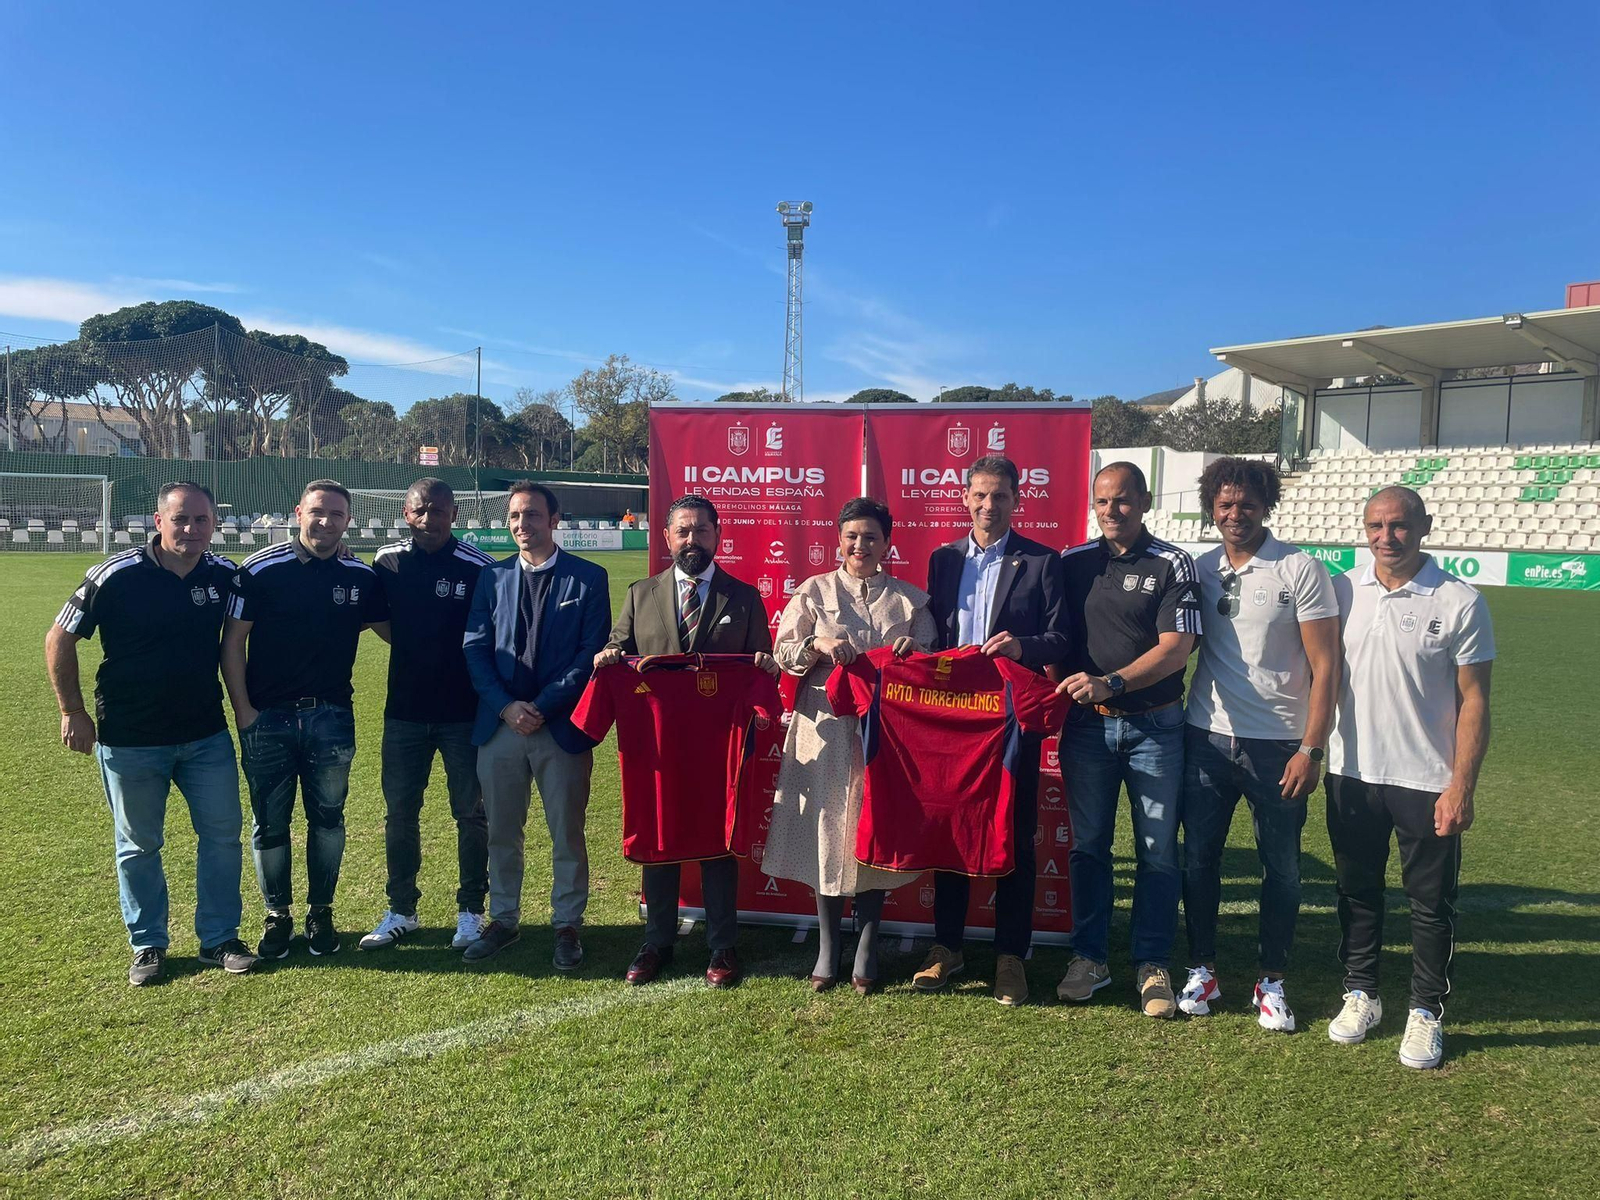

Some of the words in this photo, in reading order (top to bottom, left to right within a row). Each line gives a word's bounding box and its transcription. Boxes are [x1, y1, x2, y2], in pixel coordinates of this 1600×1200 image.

[684, 466, 697, 483] II
[702, 466, 826, 484] CAMPUS
[901, 468, 915, 485] II
[684, 486, 761, 497] LEYENDAS
[766, 485, 825, 498] ESPAÑA
[901, 489, 964, 498] LEYEND
[712, 503, 766, 511] ORREMOLINOS
[769, 503, 802, 511] MÁLAGA
[925, 505, 968, 513] TORREMOL
[763, 518, 776, 526] DEL
[812, 519, 834, 527] JULIO
[563, 531, 598, 539] territorio
[563, 539, 598, 547] BURGER
[1524, 565, 1563, 579] enPie.es
[885, 682, 914, 703] AYTO.
[919, 687, 1000, 713] TORREMOLINOS
